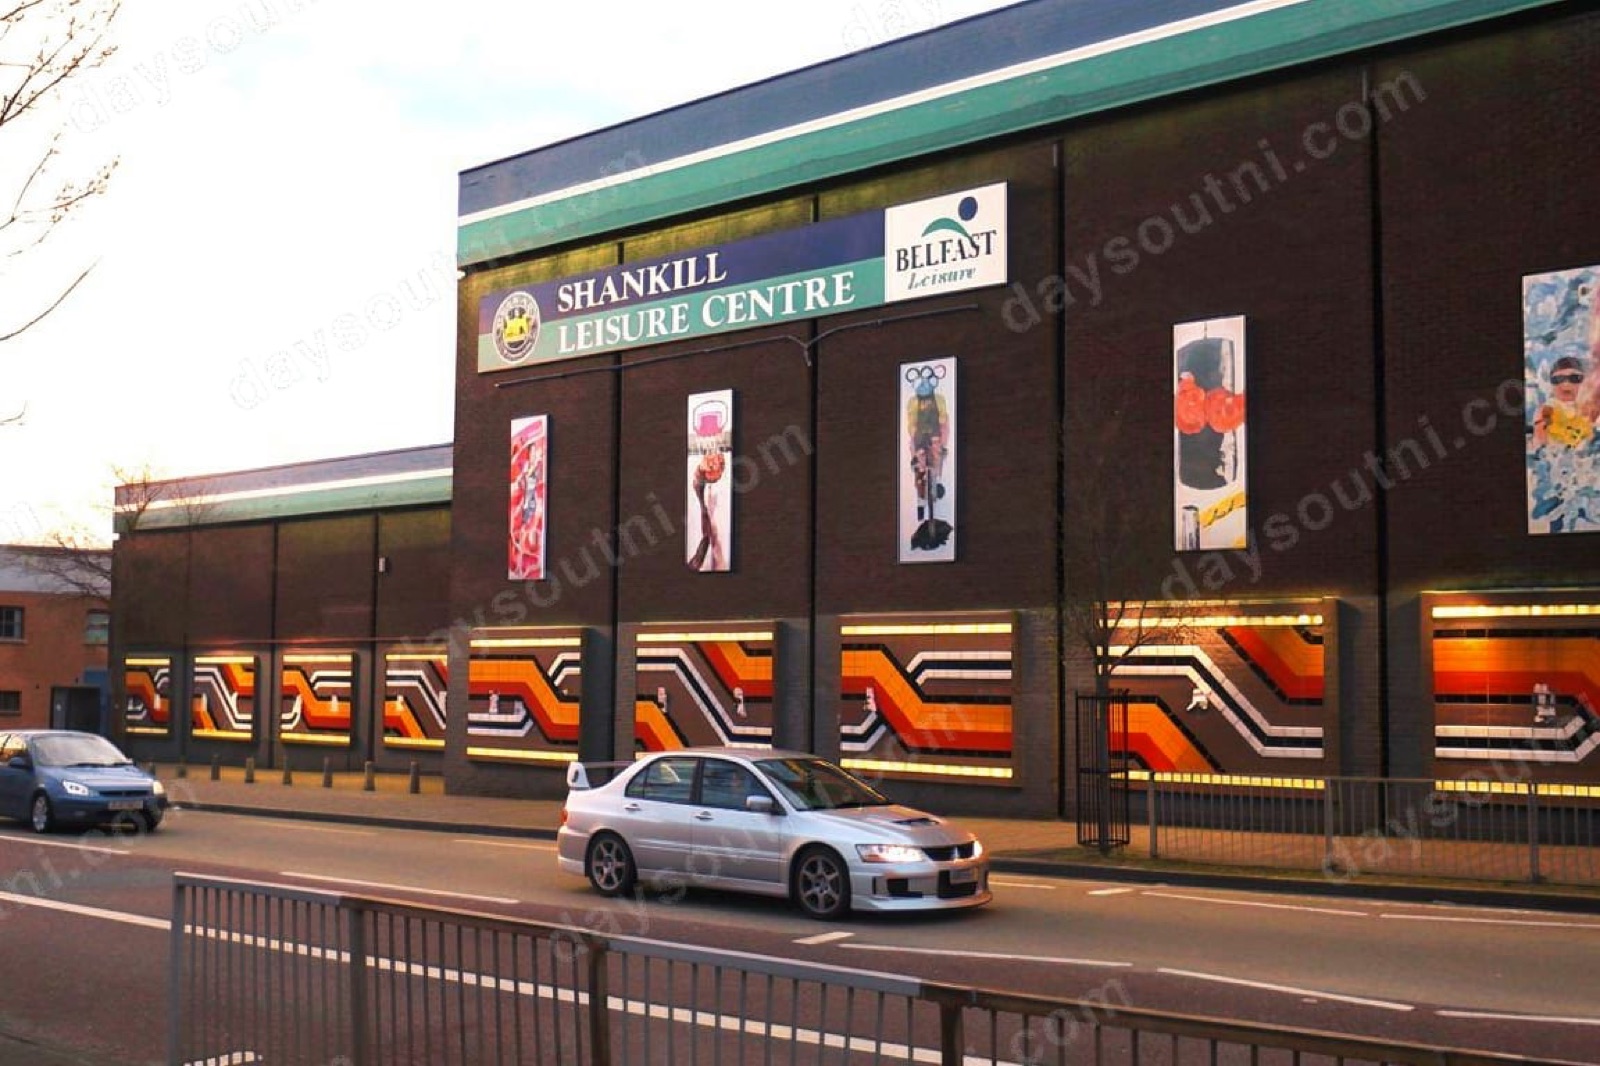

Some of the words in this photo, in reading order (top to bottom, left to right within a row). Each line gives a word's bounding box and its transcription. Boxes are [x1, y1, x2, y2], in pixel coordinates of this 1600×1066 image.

[896, 230, 997, 272] BELFAST
[558, 253, 727, 312] SHANKILL
[907, 267, 976, 290] Leisure
[558, 303, 690, 354] LEISURE
[702, 271, 856, 329] CENTRE
